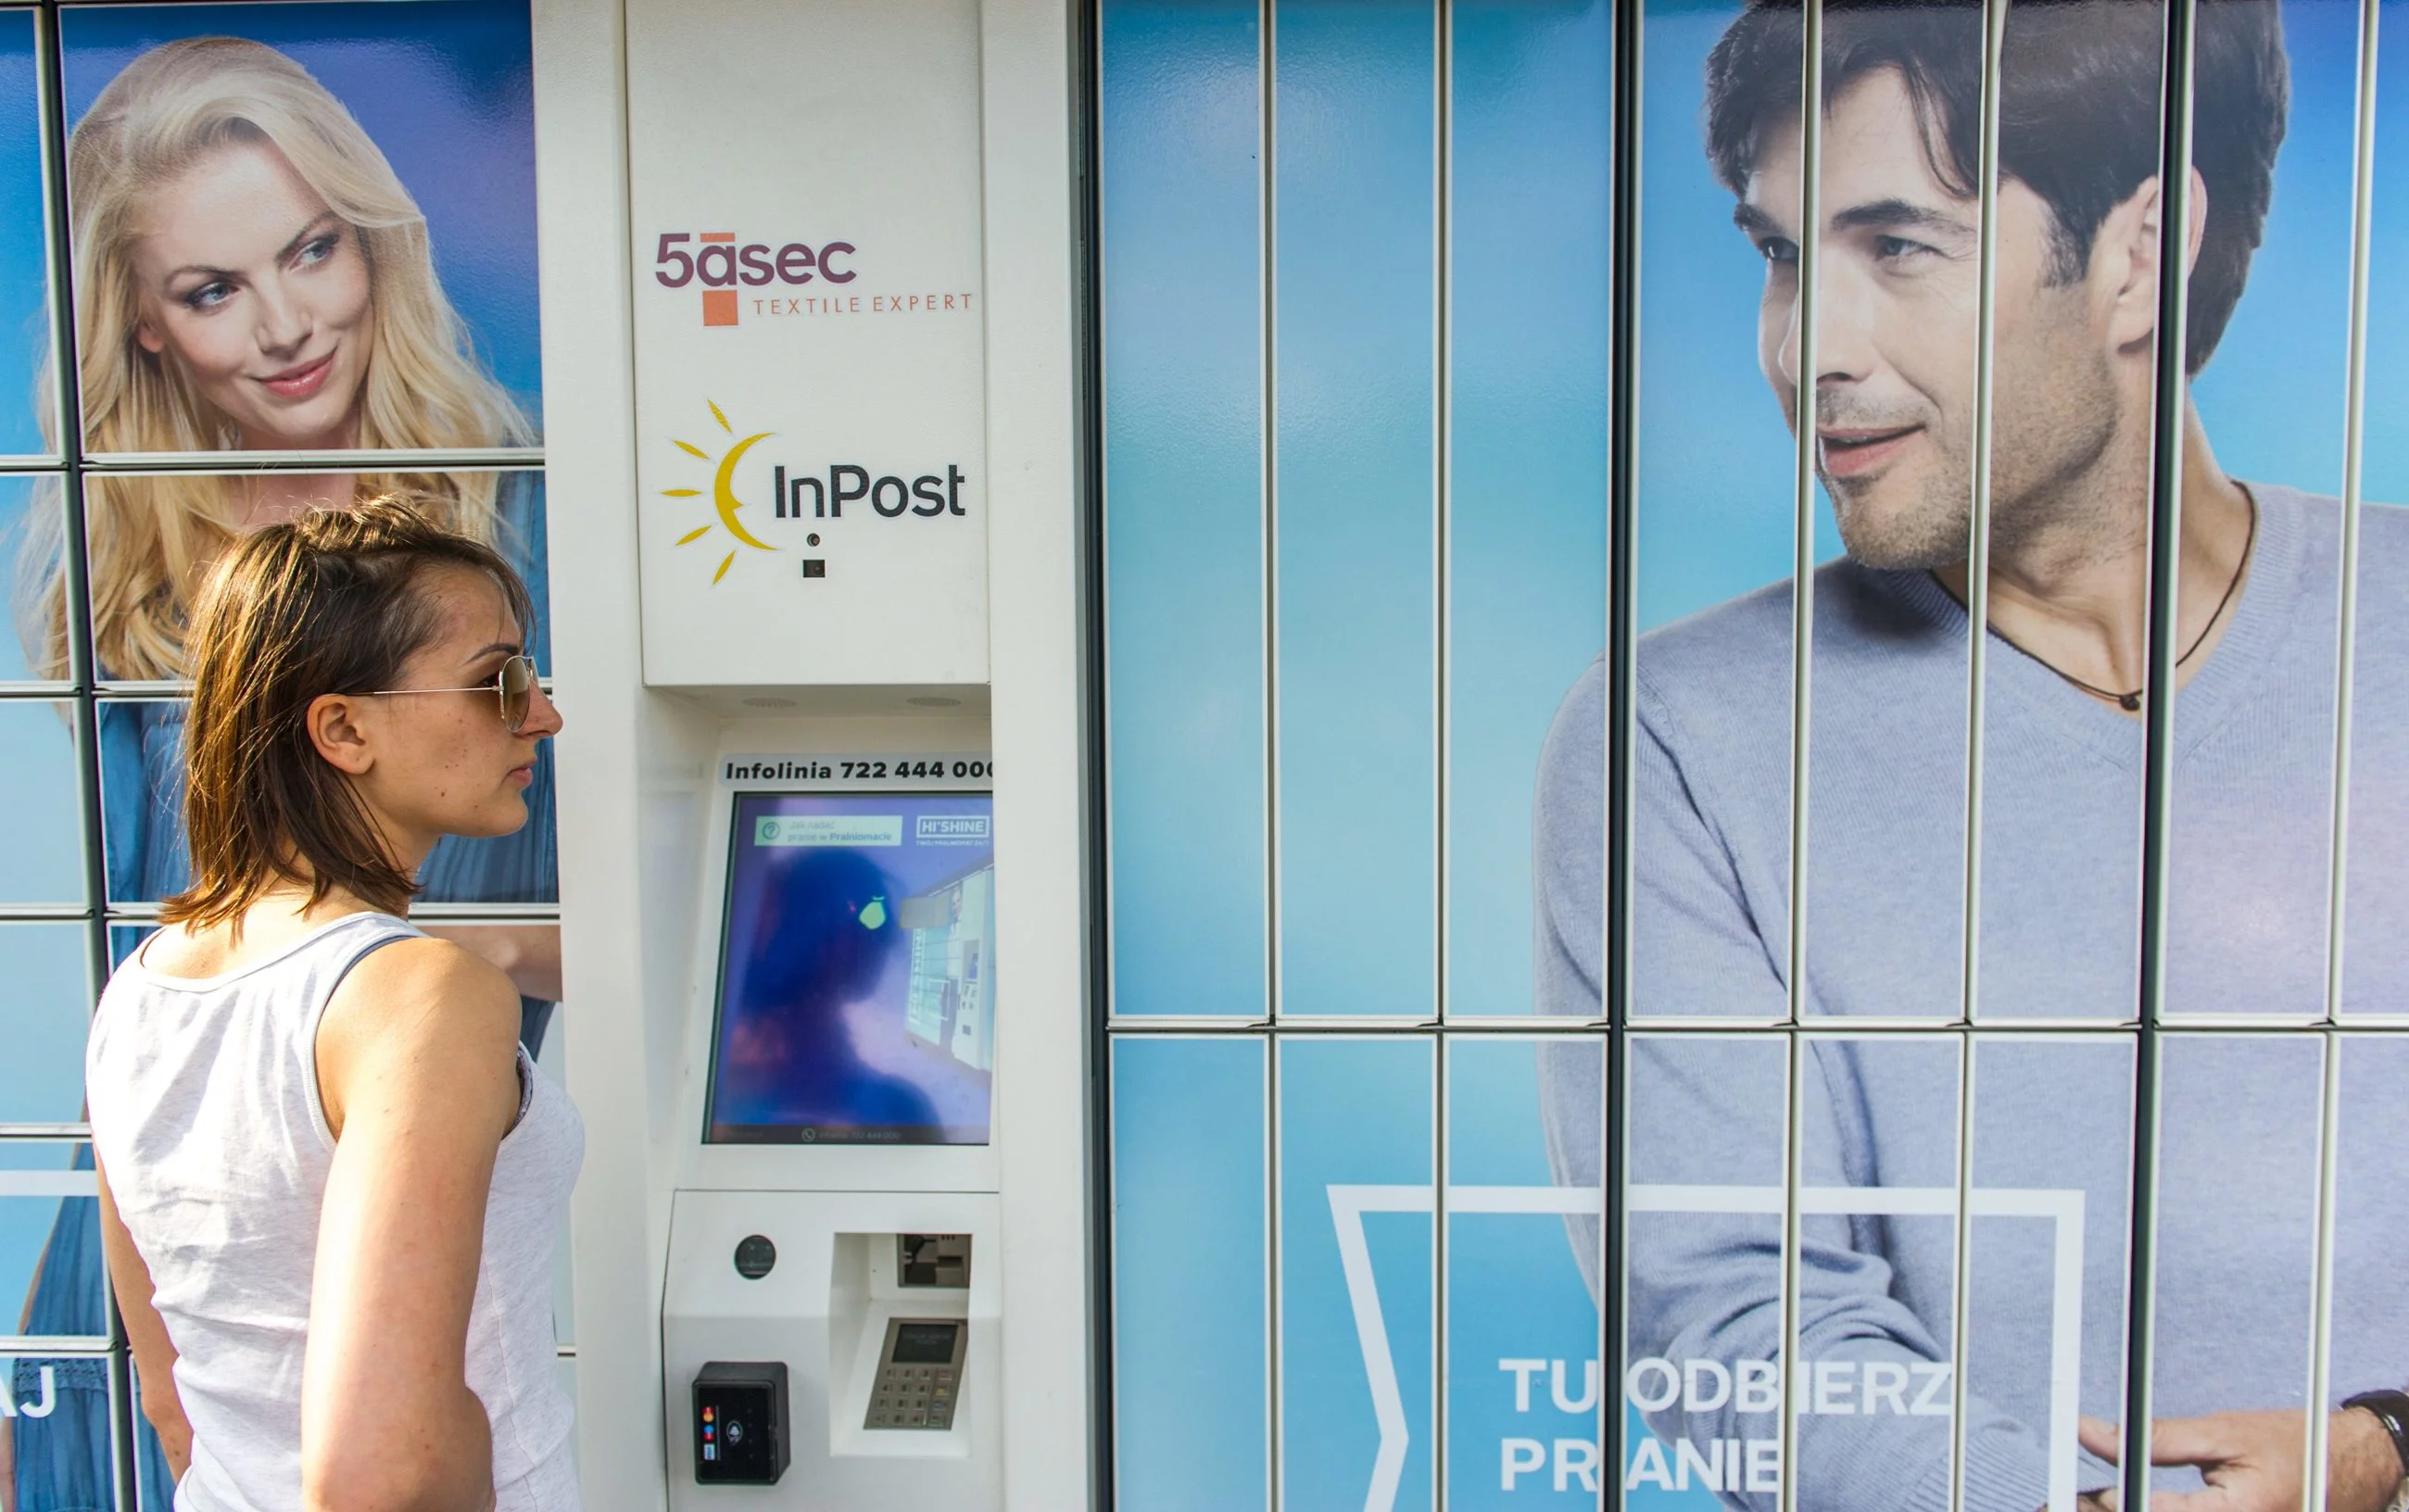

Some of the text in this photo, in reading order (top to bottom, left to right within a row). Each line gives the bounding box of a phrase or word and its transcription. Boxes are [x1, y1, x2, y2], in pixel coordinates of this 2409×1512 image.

[753, 294, 972, 315] TEXTILE EXPERT
[774, 464, 965, 518] InPost
[725, 762, 832, 779] Infolinia
[840, 762, 887, 778] 722
[895, 762, 945, 778] 444
[1498, 1357, 1952, 1416] TU ODBIERZ
[1501, 1437, 1778, 1493] PRANIE
